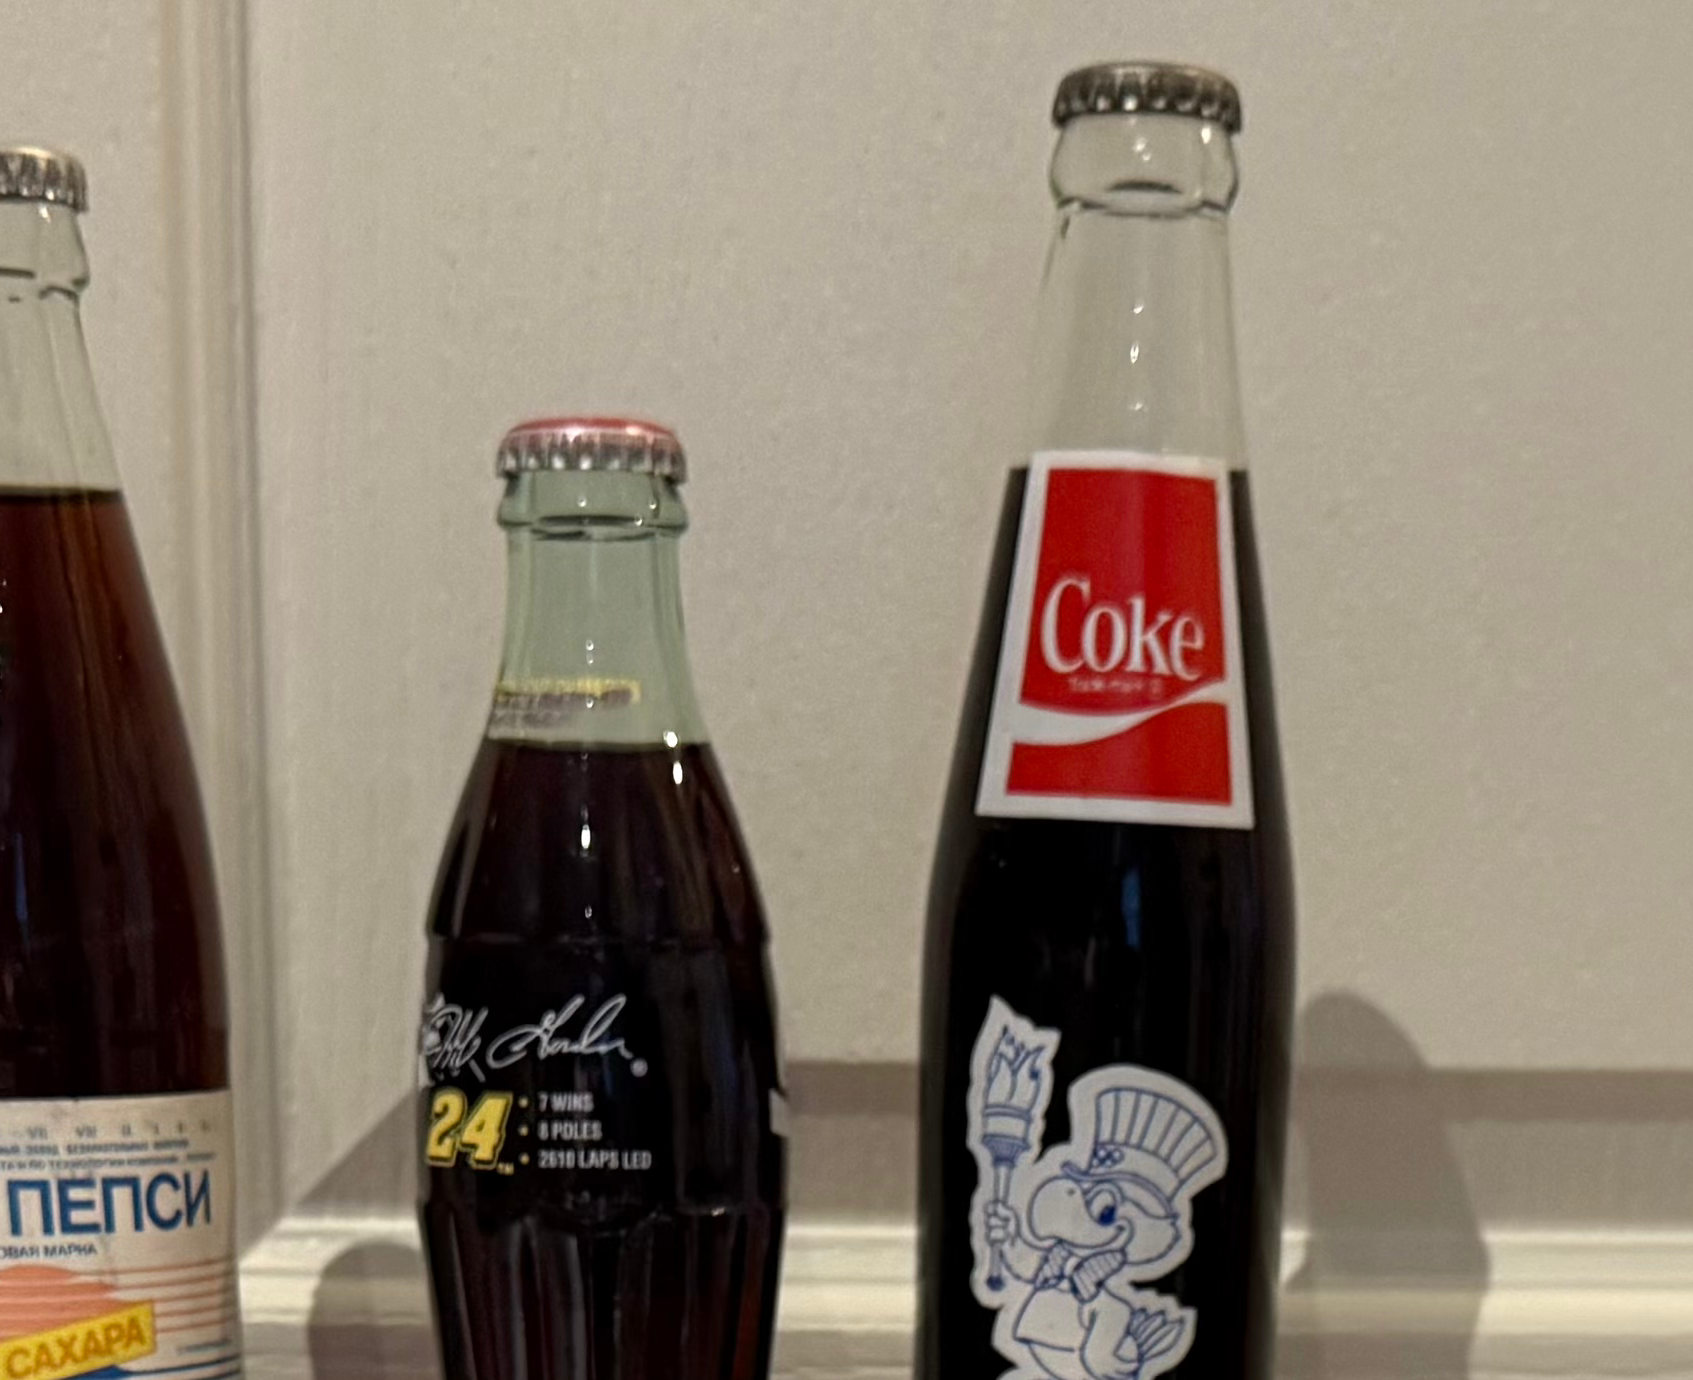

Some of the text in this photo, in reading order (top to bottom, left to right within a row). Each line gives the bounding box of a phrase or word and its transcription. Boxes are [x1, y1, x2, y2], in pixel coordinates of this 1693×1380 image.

[1041, 575, 1205, 681] Coke
[425, 1087, 514, 1170] 24
[538, 1093, 594, 1112] 7 WINS
[551, 1120, 602, 1141] POLES
[577, 1151, 619, 1169] LAPS
[622, 1151, 652, 1169] LED
[6, 1170, 211, 1237] ПЕПСИ
[7, 1316, 146, 1379] САХАРА
